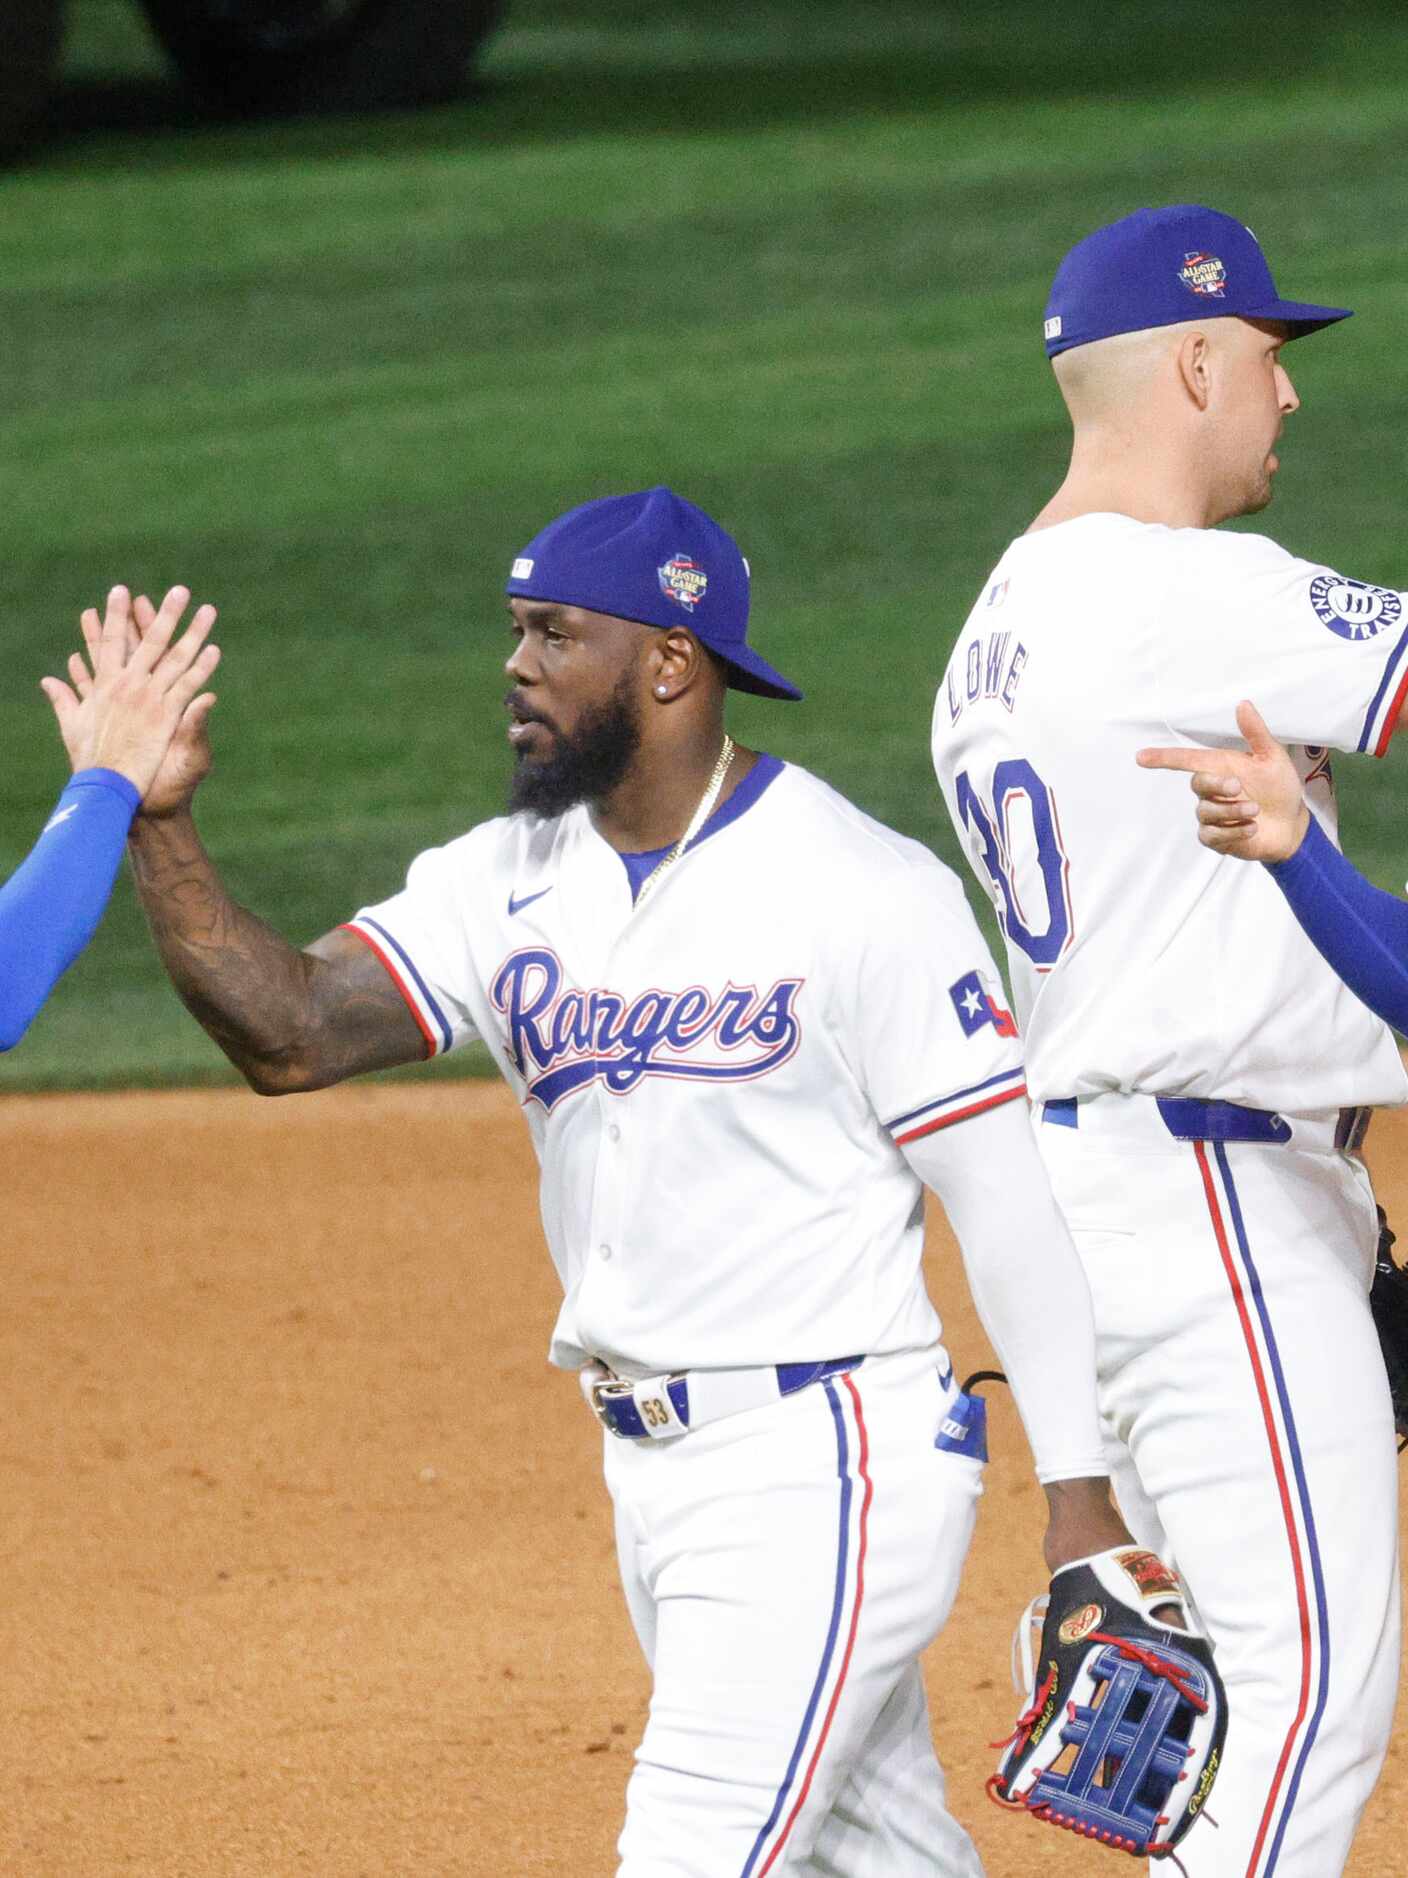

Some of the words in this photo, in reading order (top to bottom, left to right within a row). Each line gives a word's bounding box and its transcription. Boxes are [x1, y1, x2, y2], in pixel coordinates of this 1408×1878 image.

[947, 630, 1030, 728] LOWE
[490, 947, 805, 1105] Rangers
[641, 1398, 669, 1427] 53
